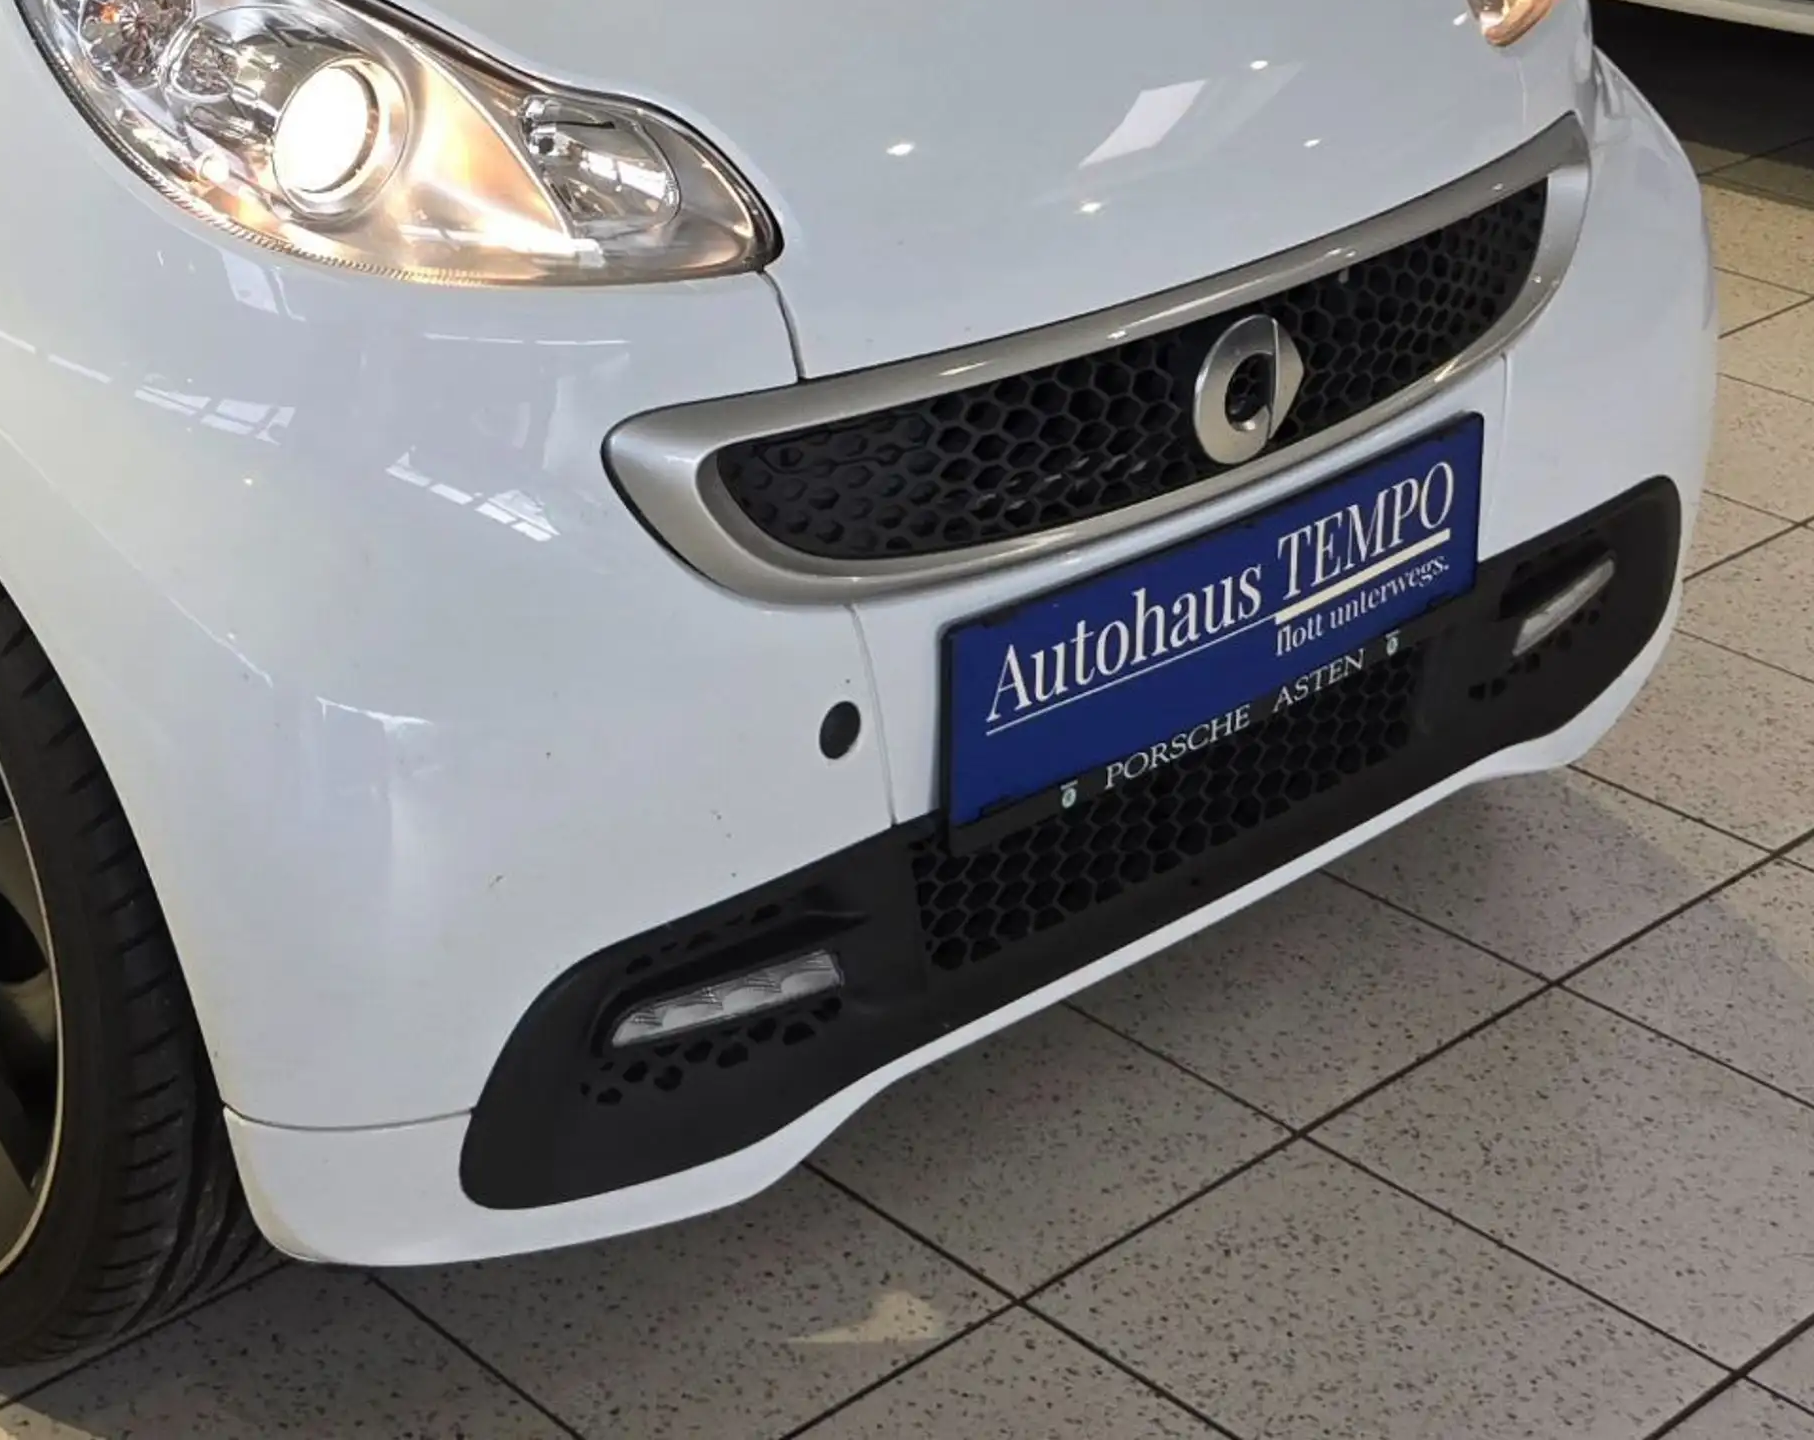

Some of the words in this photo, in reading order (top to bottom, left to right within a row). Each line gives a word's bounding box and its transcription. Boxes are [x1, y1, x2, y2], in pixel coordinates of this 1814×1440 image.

[986, 563, 1263, 723] Autohaus
[1277, 461, 1455, 601] TEMPO
[1275, 613, 1324, 657] flott
[1329, 555, 1450, 630] unterwegs.
[1104, 703, 1252, 790] PORSCHE
[1273, 648, 1367, 712] ASTEN
